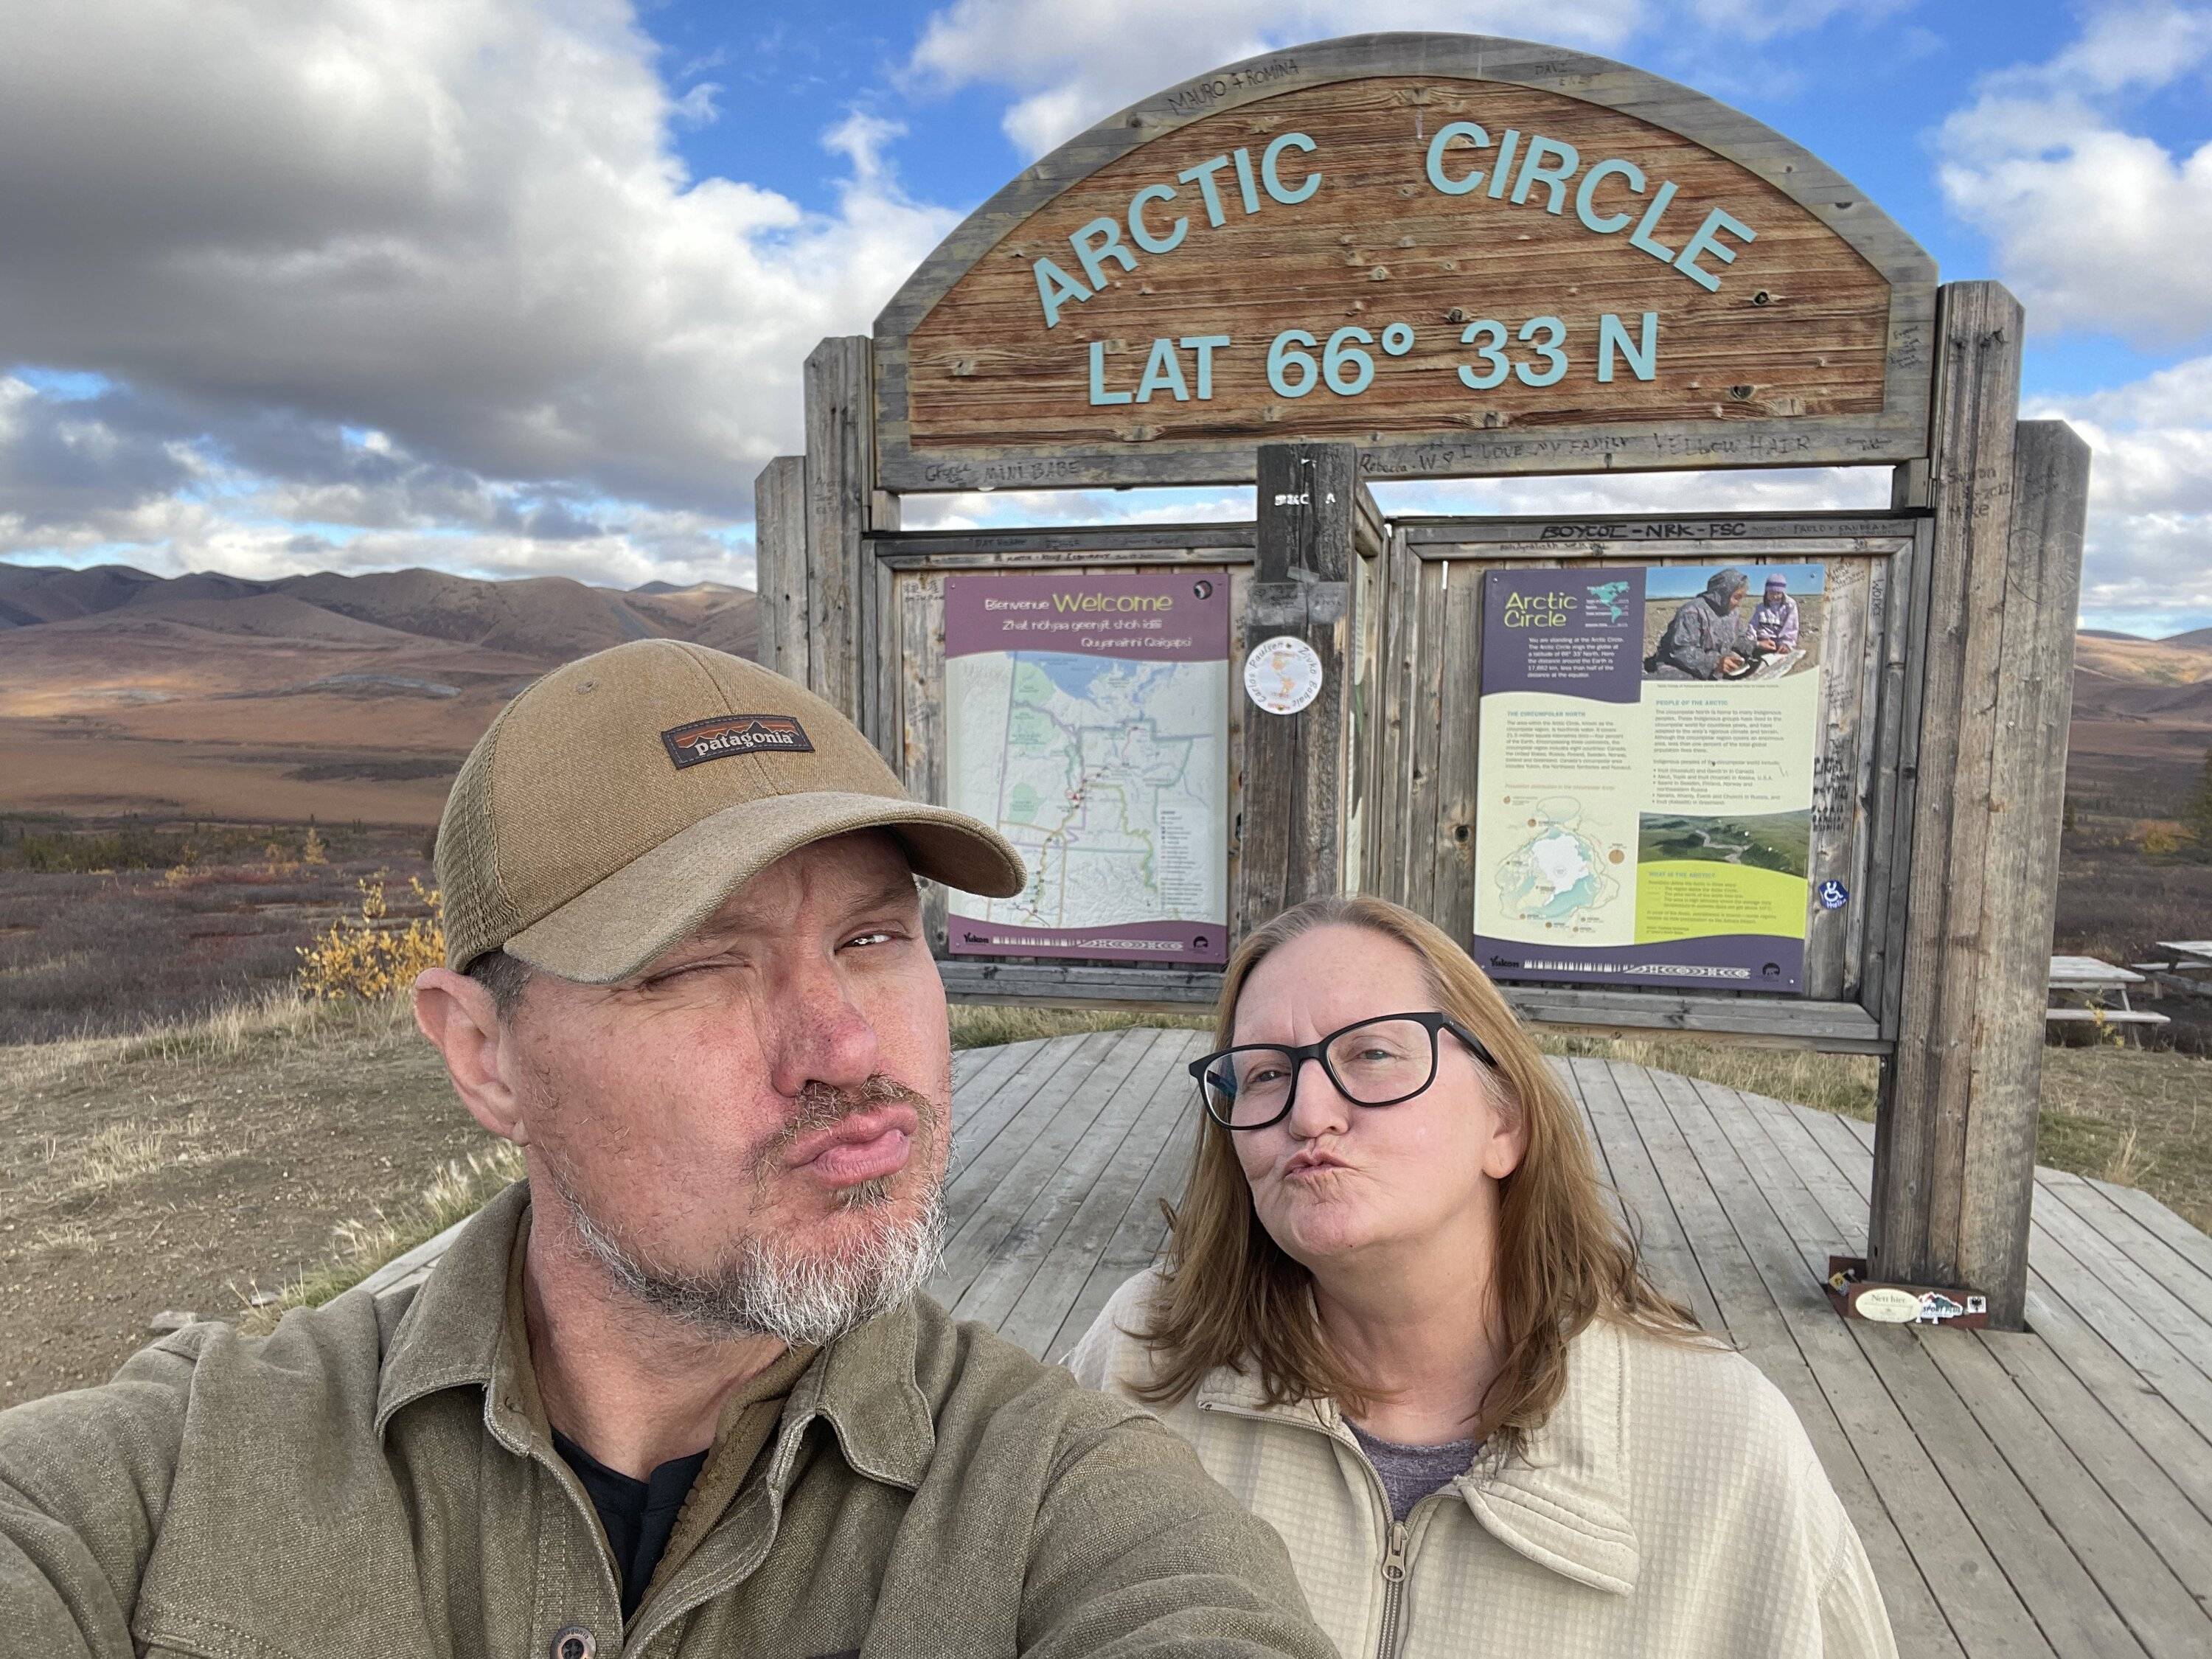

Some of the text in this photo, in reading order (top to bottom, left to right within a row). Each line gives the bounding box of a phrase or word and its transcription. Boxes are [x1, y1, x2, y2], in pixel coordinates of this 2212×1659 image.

[1166, 80, 1227, 116] MAURO
[1032, 121, 1756, 329] ARCTIC CIRCLE
[1089, 335, 1231, 406] LAT
[1458, 316, 1568, 390] 33
[1598, 311, 1658, 383] N
[984, 592, 1173, 613] Bienvenue Welcome
[1505, 592, 1578, 610] Arctic
[1504, 610, 1567, 627] Circle
[1248, 673, 1267, 703] Carlos
[694, 731, 794, 757] patagonia
[963, 932, 990, 944] Yukon
[1489, 956, 1520, 967] Yukon
